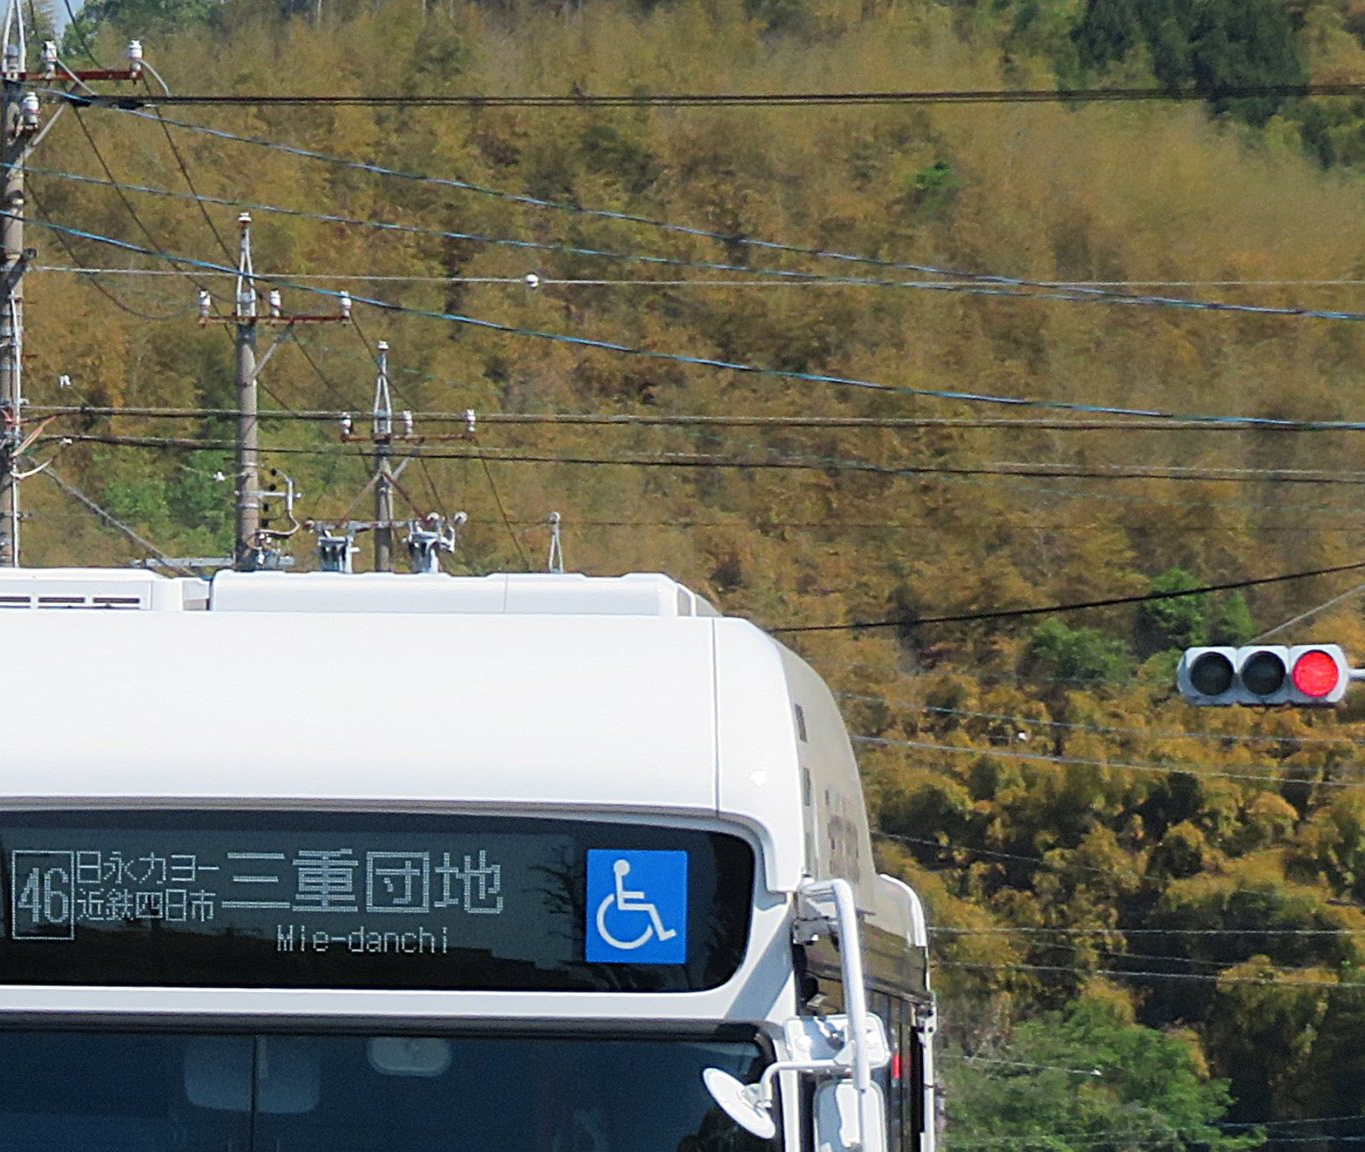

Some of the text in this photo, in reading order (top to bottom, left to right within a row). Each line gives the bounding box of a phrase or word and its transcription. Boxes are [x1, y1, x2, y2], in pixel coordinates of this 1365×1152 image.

[17, 867, 68, 923] 46
[221, 848, 504, 914] 三重団地
[76, 888, 217, 922] 近鉄四日市
[276, 925, 448, 954] Mie-danchi
